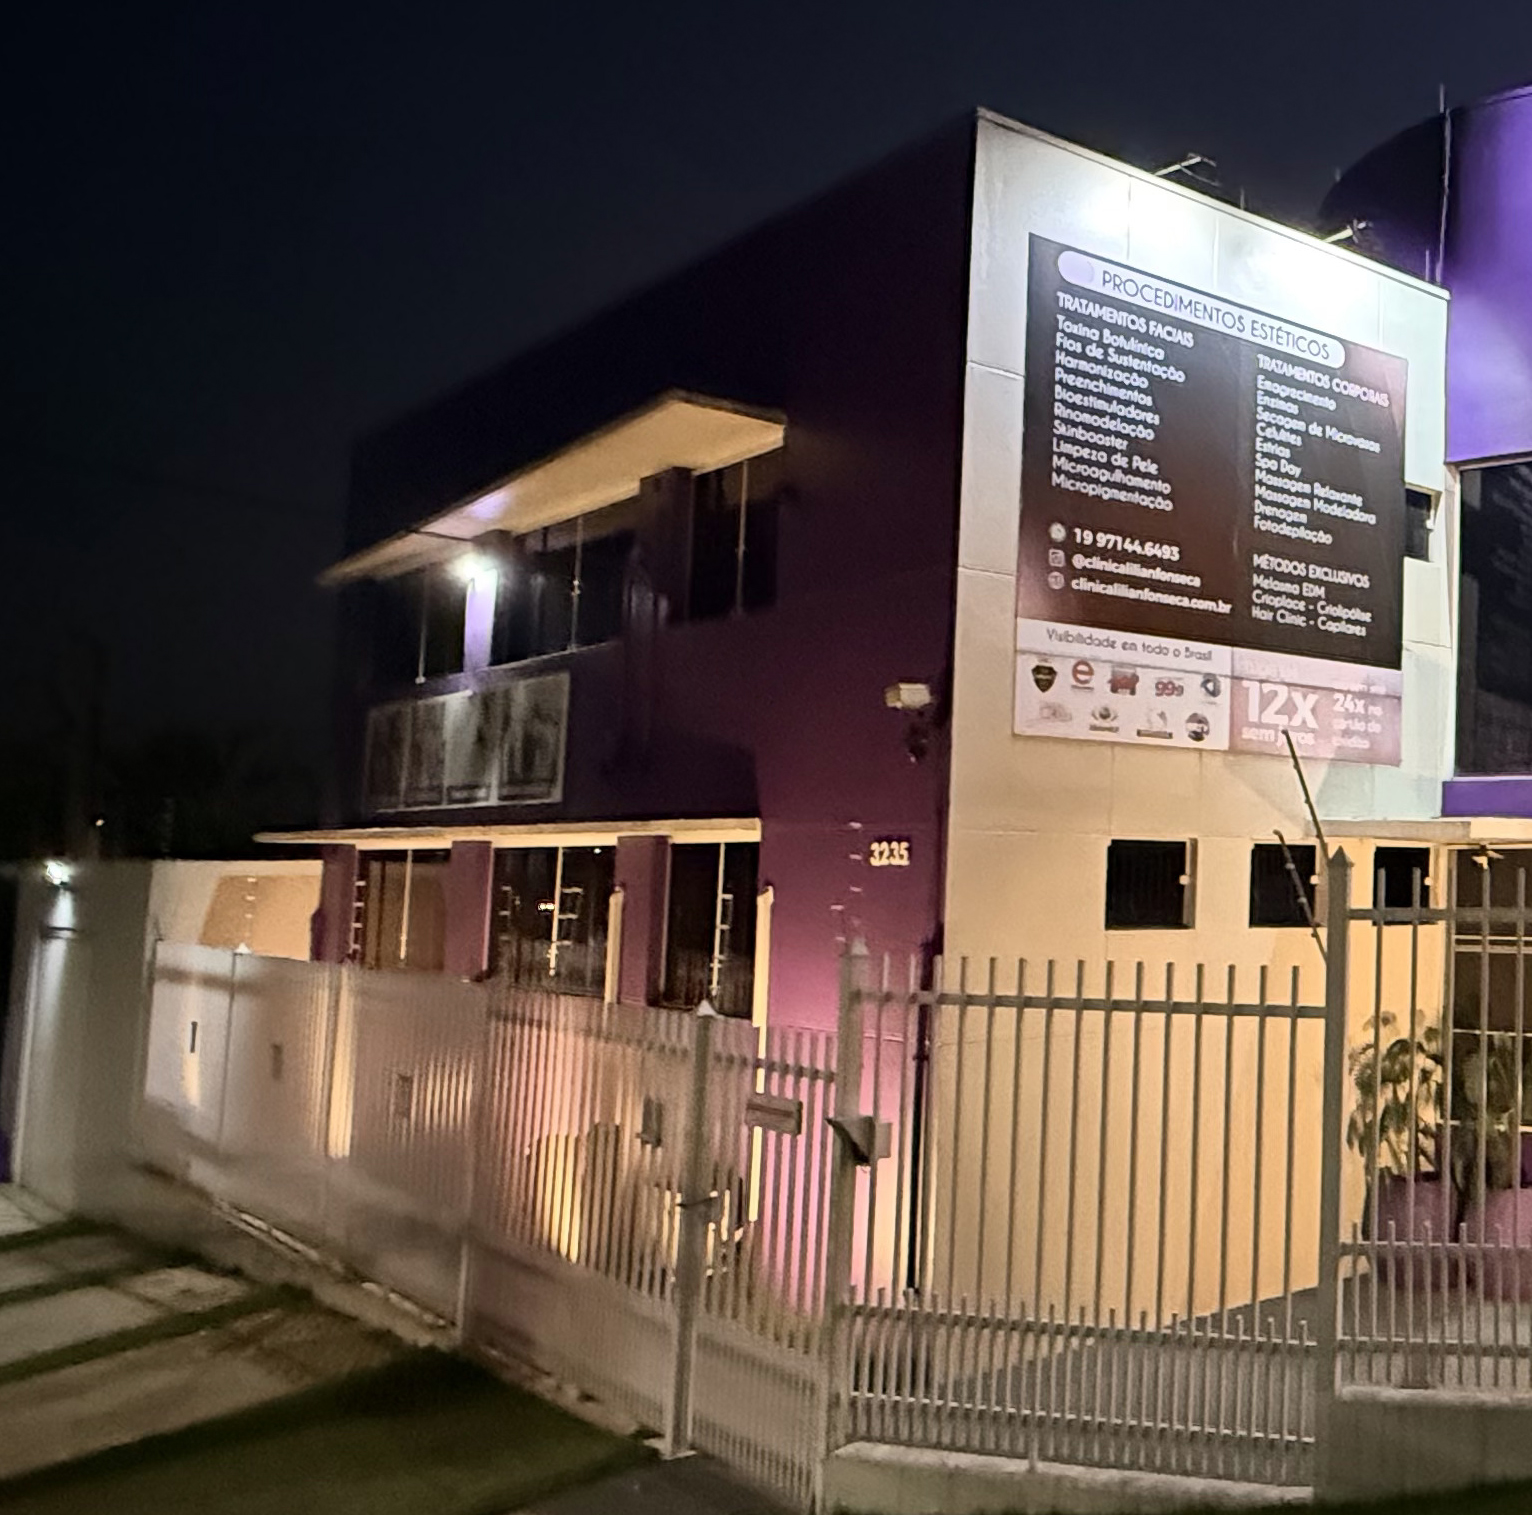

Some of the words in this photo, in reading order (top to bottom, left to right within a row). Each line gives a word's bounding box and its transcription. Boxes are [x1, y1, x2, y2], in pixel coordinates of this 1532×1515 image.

[1056, 291, 1147, 333] TRATAMENTOS
[1148, 320, 1194, 348] FACIAIS
[1056, 314, 1100, 341] Toxina
[1102, 270, 1245, 333] PROCEDIMENTOS
[1250, 322, 1330, 361] ESTÉTICOS
[1055, 349, 1149, 389] Harmonização
[1056, 332, 1082, 353] Fios
[1085, 343, 1104, 359] de
[1107, 347, 1186, 383] Sustentação
[1055, 366, 1153, 406] Preenchimentos
[1257, 353, 1330, 389] TRATAMENTOS
[1332, 378, 1390, 407] CORPORAIS
[1257, 374, 1336, 411] Emagrecimento
[1054, 401, 1155, 440] Rinomodelação
[1055, 384, 1160, 425] Bioestimuladores
[1256, 406, 1307, 432] Secagem
[1308, 421, 1323, 437] de
[1053, 419, 1129, 450] Skinbooster
[1255, 437, 1292, 459] Estrias
[1052, 437, 1108, 463] Limpeza
[1111, 452, 1129, 468] de
[1132, 455, 1159, 475] Pele
[1255, 453, 1278, 471] Spa
[1280, 459, 1302, 478] Day
[1052, 454, 1172, 494] Microagulhamento
[1052, 471, 1174, 511] Micropigmentação
[1255, 469, 1312, 494] Massagem
[1254, 499, 1308, 524] Drenagem
[1255, 484, 1312, 509] Massagem
[1314, 498, 1377, 525] Modeladora
[1073, 527, 1094, 545] 19
[1096, 532, 1181, 561] 97144.6493
[1253, 514, 1333, 545] Fotodepilação
[1252, 574, 1300, 595] Melasma
[1253, 553, 1307, 577] MÉTODOS
[1308, 564, 1370, 589] EXCLUSIVOS
[1251, 605, 1275, 622] Hair
[1276, 610, 1307, 627] Clinic
[1046, 627, 1117, 650] Visibilidade
[1121, 641, 1138, 652] em
[1142, 642, 1169, 656] todo
[1172, 648, 1181, 657] o
[1184, 647, 1213, 661] Brasil
[1241, 727, 1275, 742] sem
[869, 841, 910, 866] 3235
